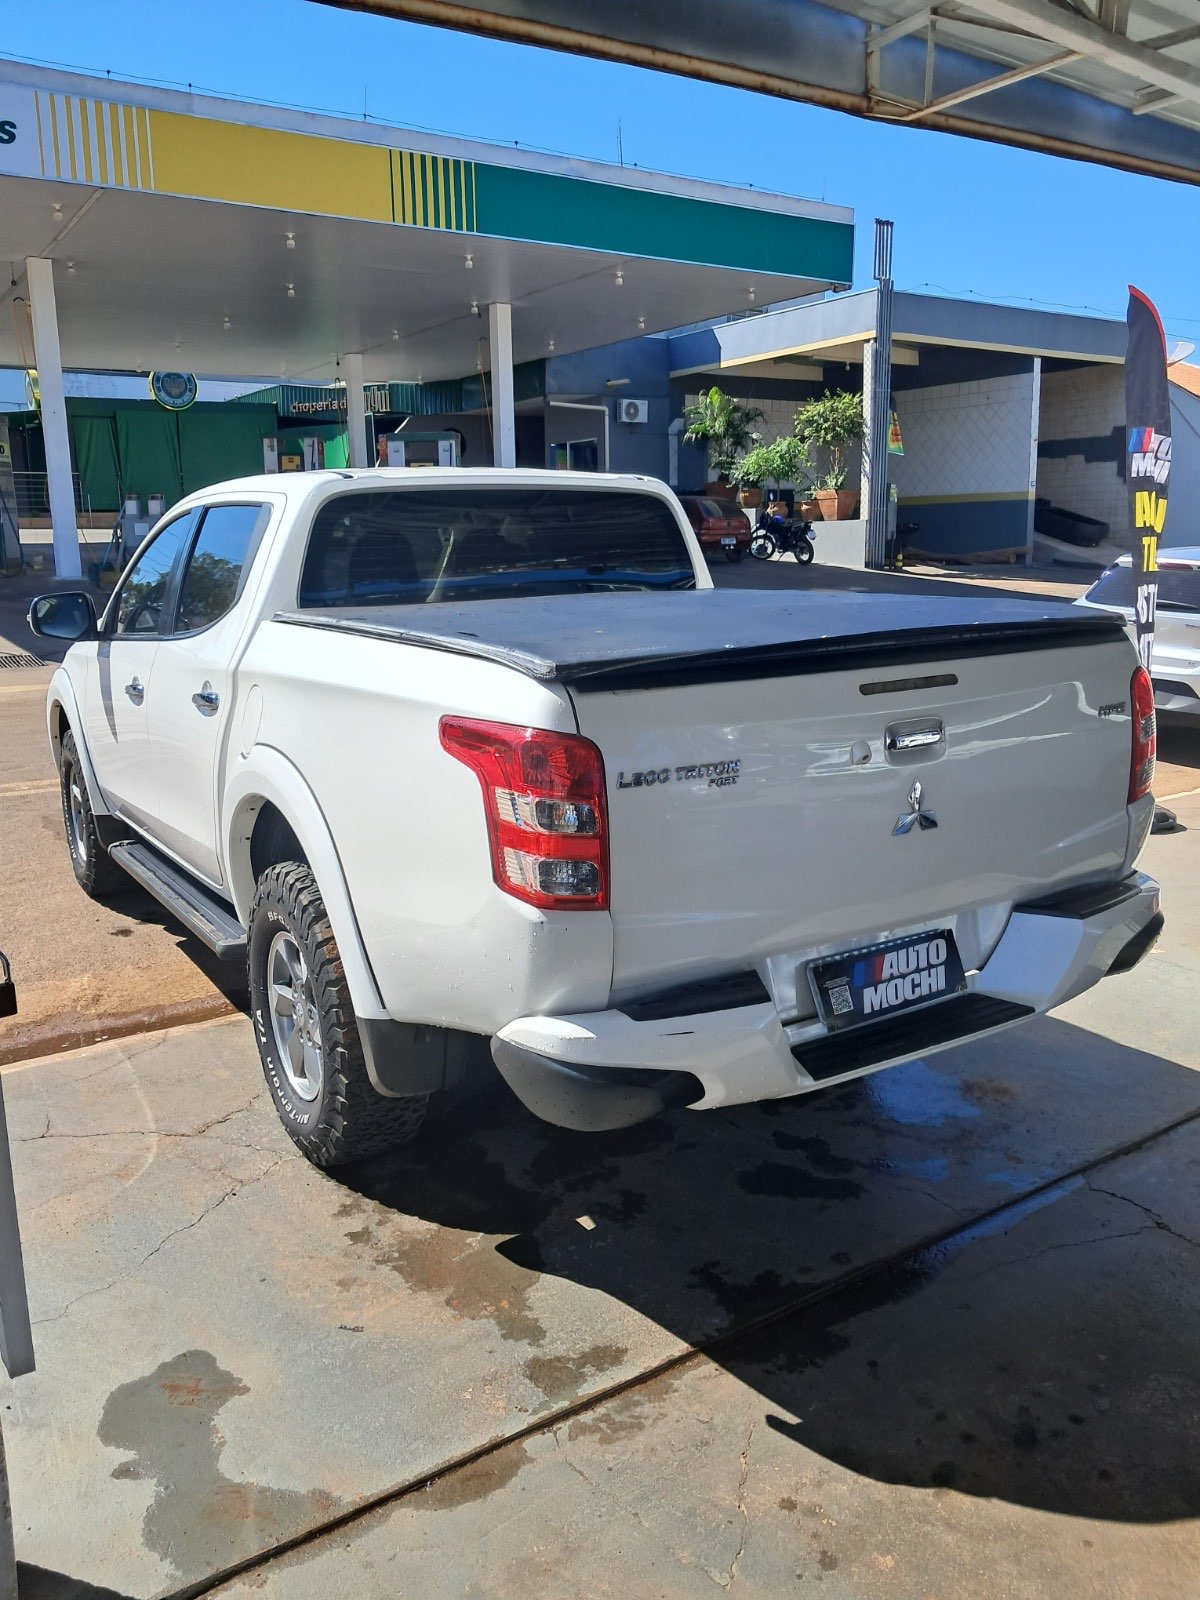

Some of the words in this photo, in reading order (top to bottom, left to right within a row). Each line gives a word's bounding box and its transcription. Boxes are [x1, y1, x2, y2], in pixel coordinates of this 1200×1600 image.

[616, 767, 671, 790] L200
[674, 758, 741, 782] TRITON
[881, 938, 947, 981] AUTO
[863, 965, 947, 1015] MOCHI
